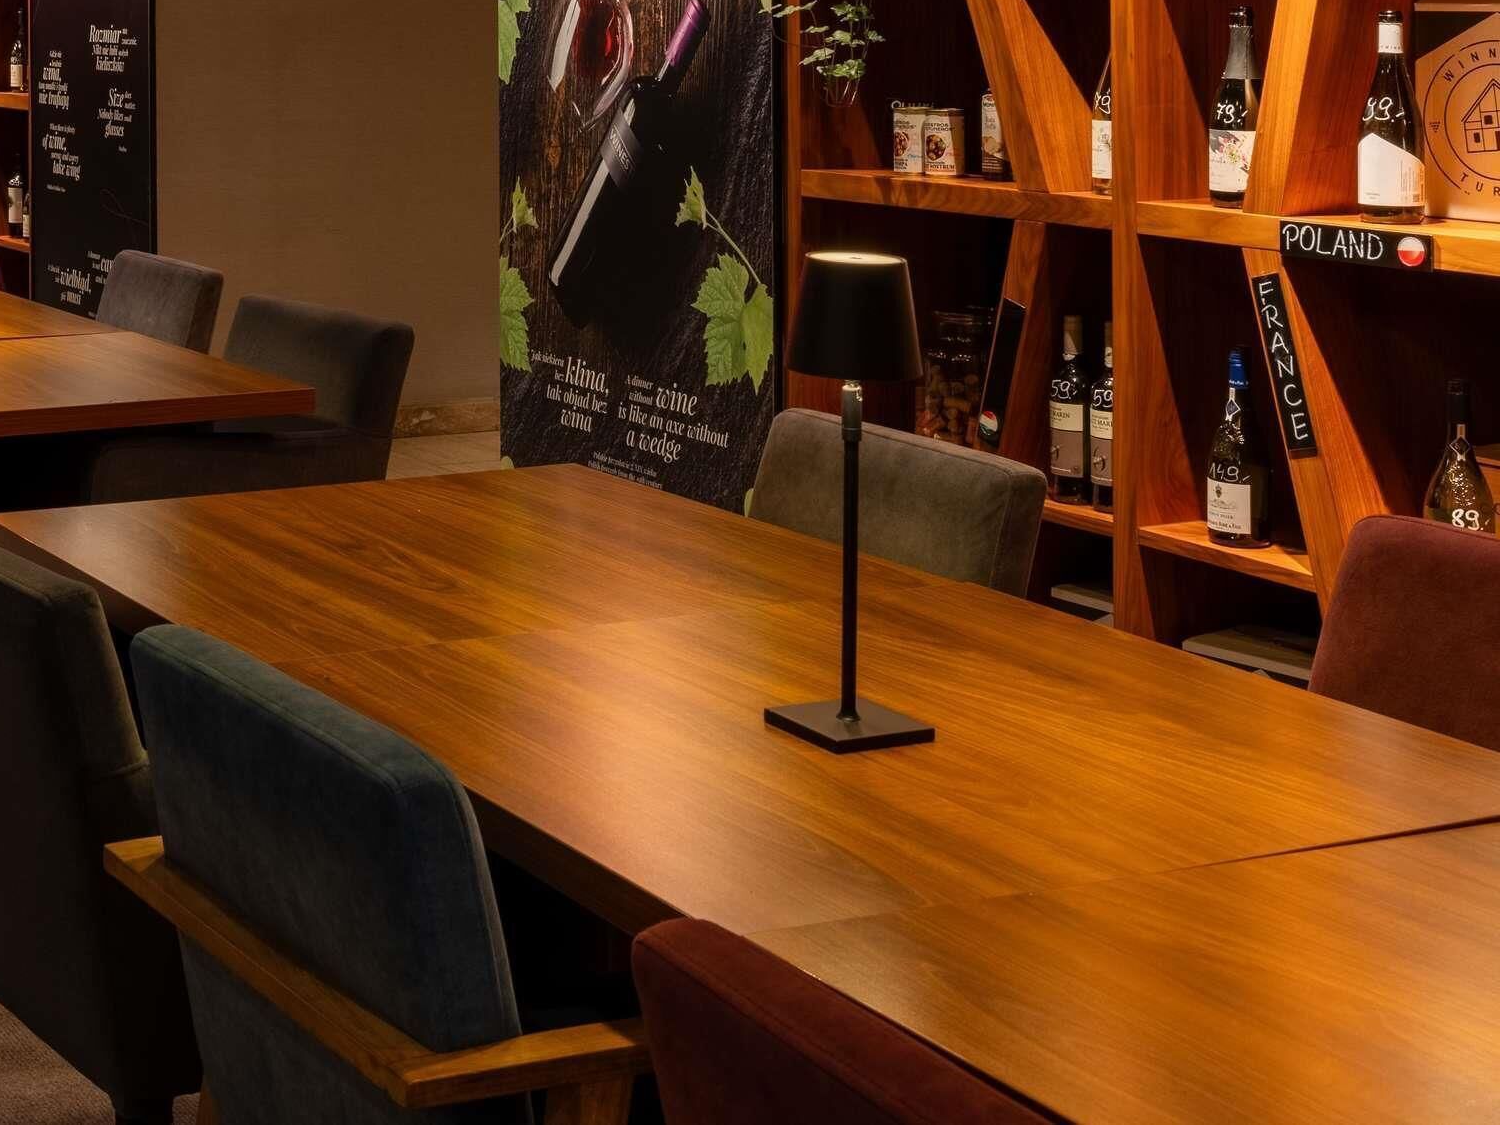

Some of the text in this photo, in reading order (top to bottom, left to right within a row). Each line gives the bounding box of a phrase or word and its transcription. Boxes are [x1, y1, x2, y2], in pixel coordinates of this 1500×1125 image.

[1443, 48, 1499, 82] WINN
[108, 87, 125, 108] Size
[1281, 222, 1384, 261] POLAND
[565, 356, 610, 397] klina,
[1257, 280, 1309, 442] FRANCE
[546, 383, 608, 414] tak obiad bez
[656, 382, 698, 416] wine
[560, 405, 592, 432] wina
[618, 401, 730, 449] is like an axe without
[626, 429, 682, 464] a wedge
